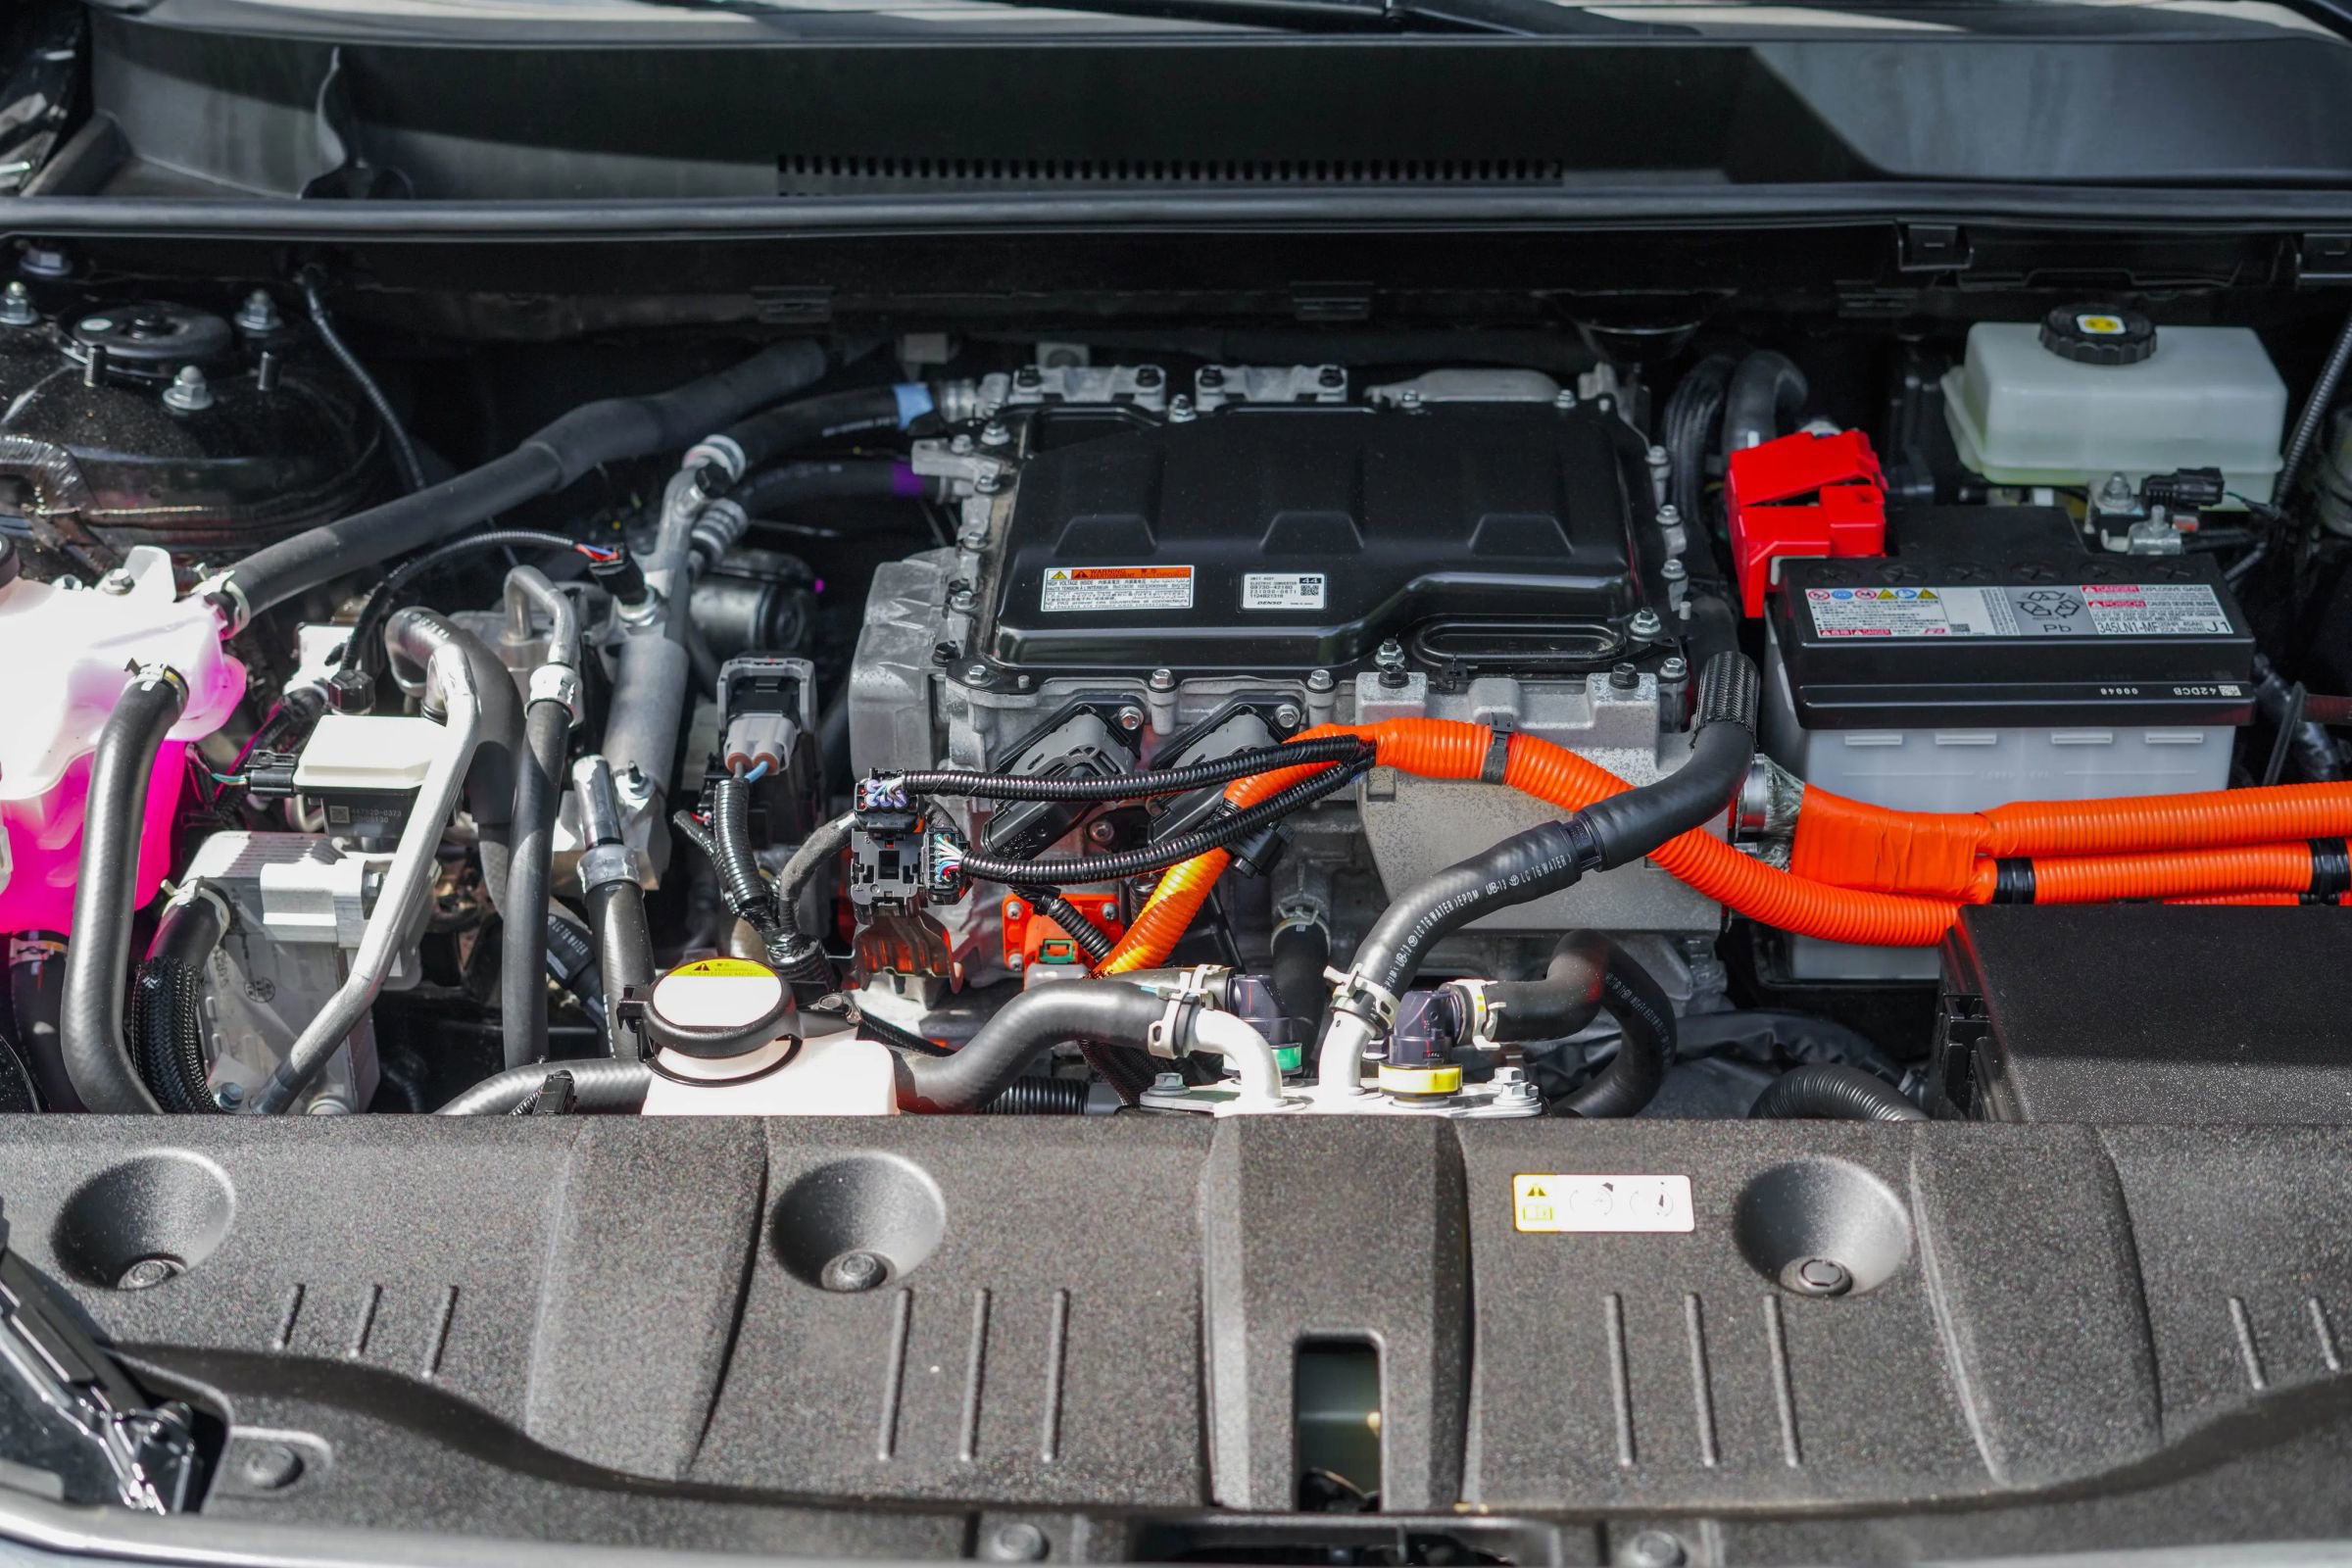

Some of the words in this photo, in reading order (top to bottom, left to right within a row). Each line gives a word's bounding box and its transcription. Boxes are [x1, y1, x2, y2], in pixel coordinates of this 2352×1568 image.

[2043, 623, 2072, 633] Pb
[2097, 621, 2158, 633] 345LN1-MF
[2206, 620, 2230, 632] J1
[2173, 687, 2217, 696] 42DCB
[1429, 900, 1454, 922] WATER
[1520, 870, 1532, 883] LC
[1542, 855, 1567, 874] WATER
